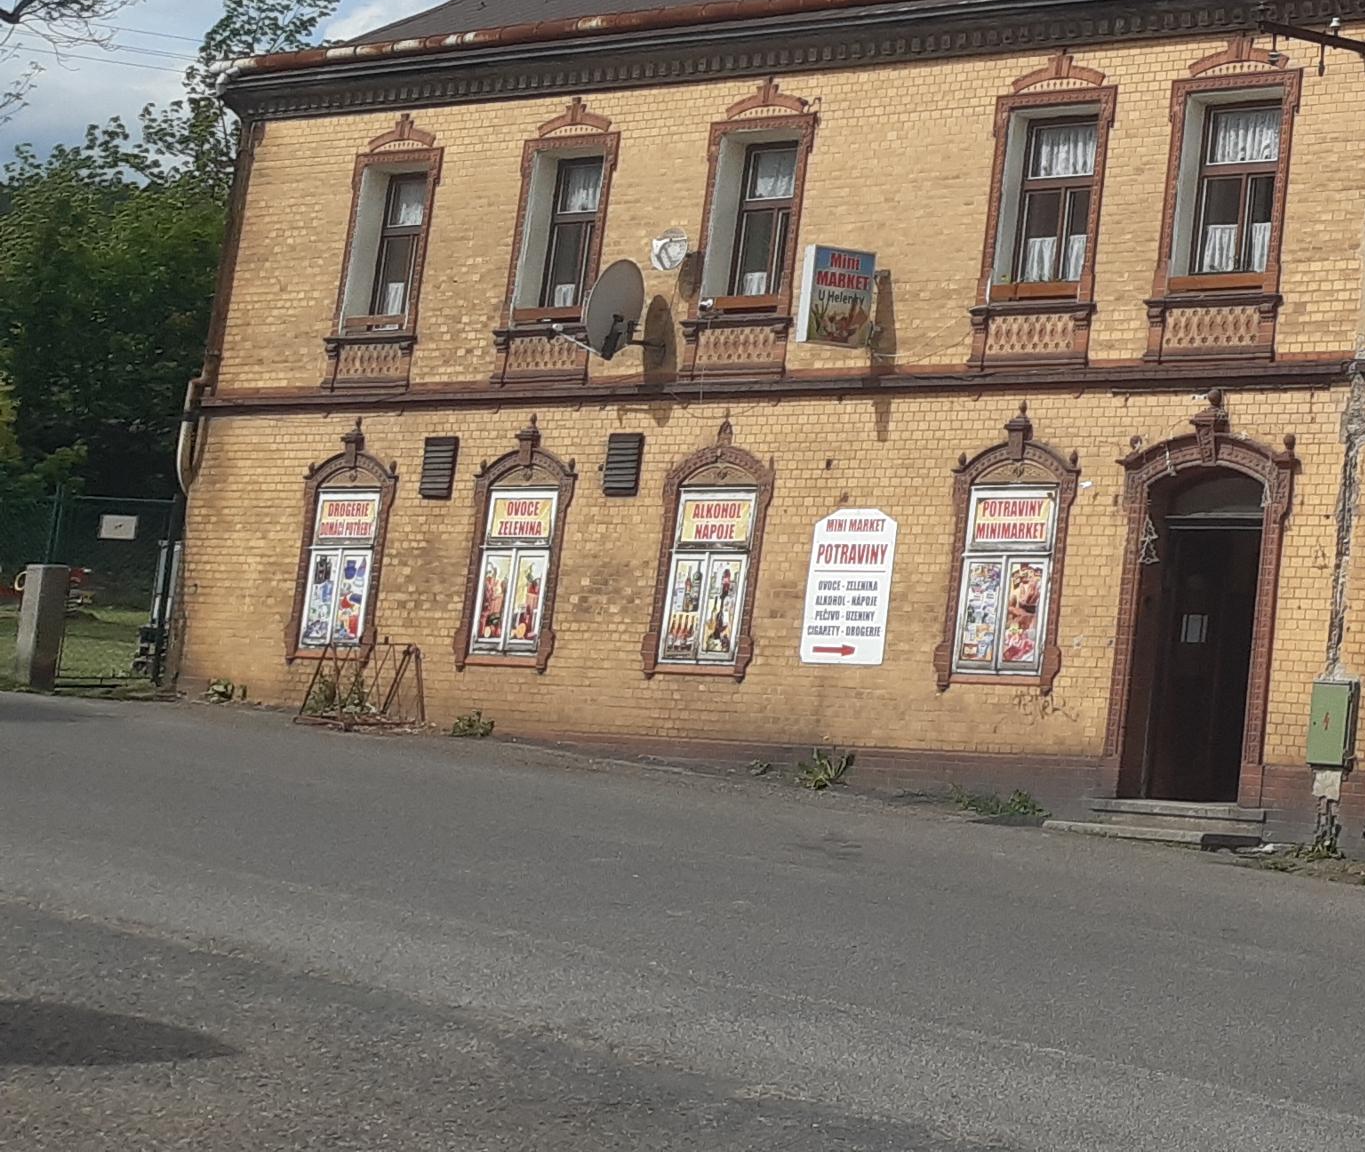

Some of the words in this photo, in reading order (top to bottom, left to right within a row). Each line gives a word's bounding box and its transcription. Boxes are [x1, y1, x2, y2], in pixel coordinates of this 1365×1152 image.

[831, 252, 860, 270] Mini
[816, 271, 870, 290] MARKET
[818, 289, 826, 301] U
[328, 502, 369, 517] DROGERIE
[507, 501, 540, 516] OVOCE
[692, 503, 741, 519] ALKOHOL
[982, 500, 1044, 517] POTRAVINY
[320, 519, 345, 536] DOMÁCÍ
[345, 519, 372, 536] POTŘEBY
[498, 521, 542, 535] ZELENINA
[694, 521, 736, 540] NÁPOJE
[826, 519, 847, 532] MINI
[848, 519, 886, 532] MARKET
[976, 522, 1046, 539] MINIMARKET
[816, 543, 888, 565] POTRAVINY
[818, 581, 840, 591] OVOCE
[846, 581, 878, 591] ZELENINA
[815, 595, 845, 606] ALKOHOL
[851, 594, 878, 606] NÁPOJE
[814, 608, 840, 621] PEČIVO
[845, 611, 875, 621] UZENINY
[807, 625, 840, 636] CIGARETY
[845, 626, 881, 637] DROGERIE
